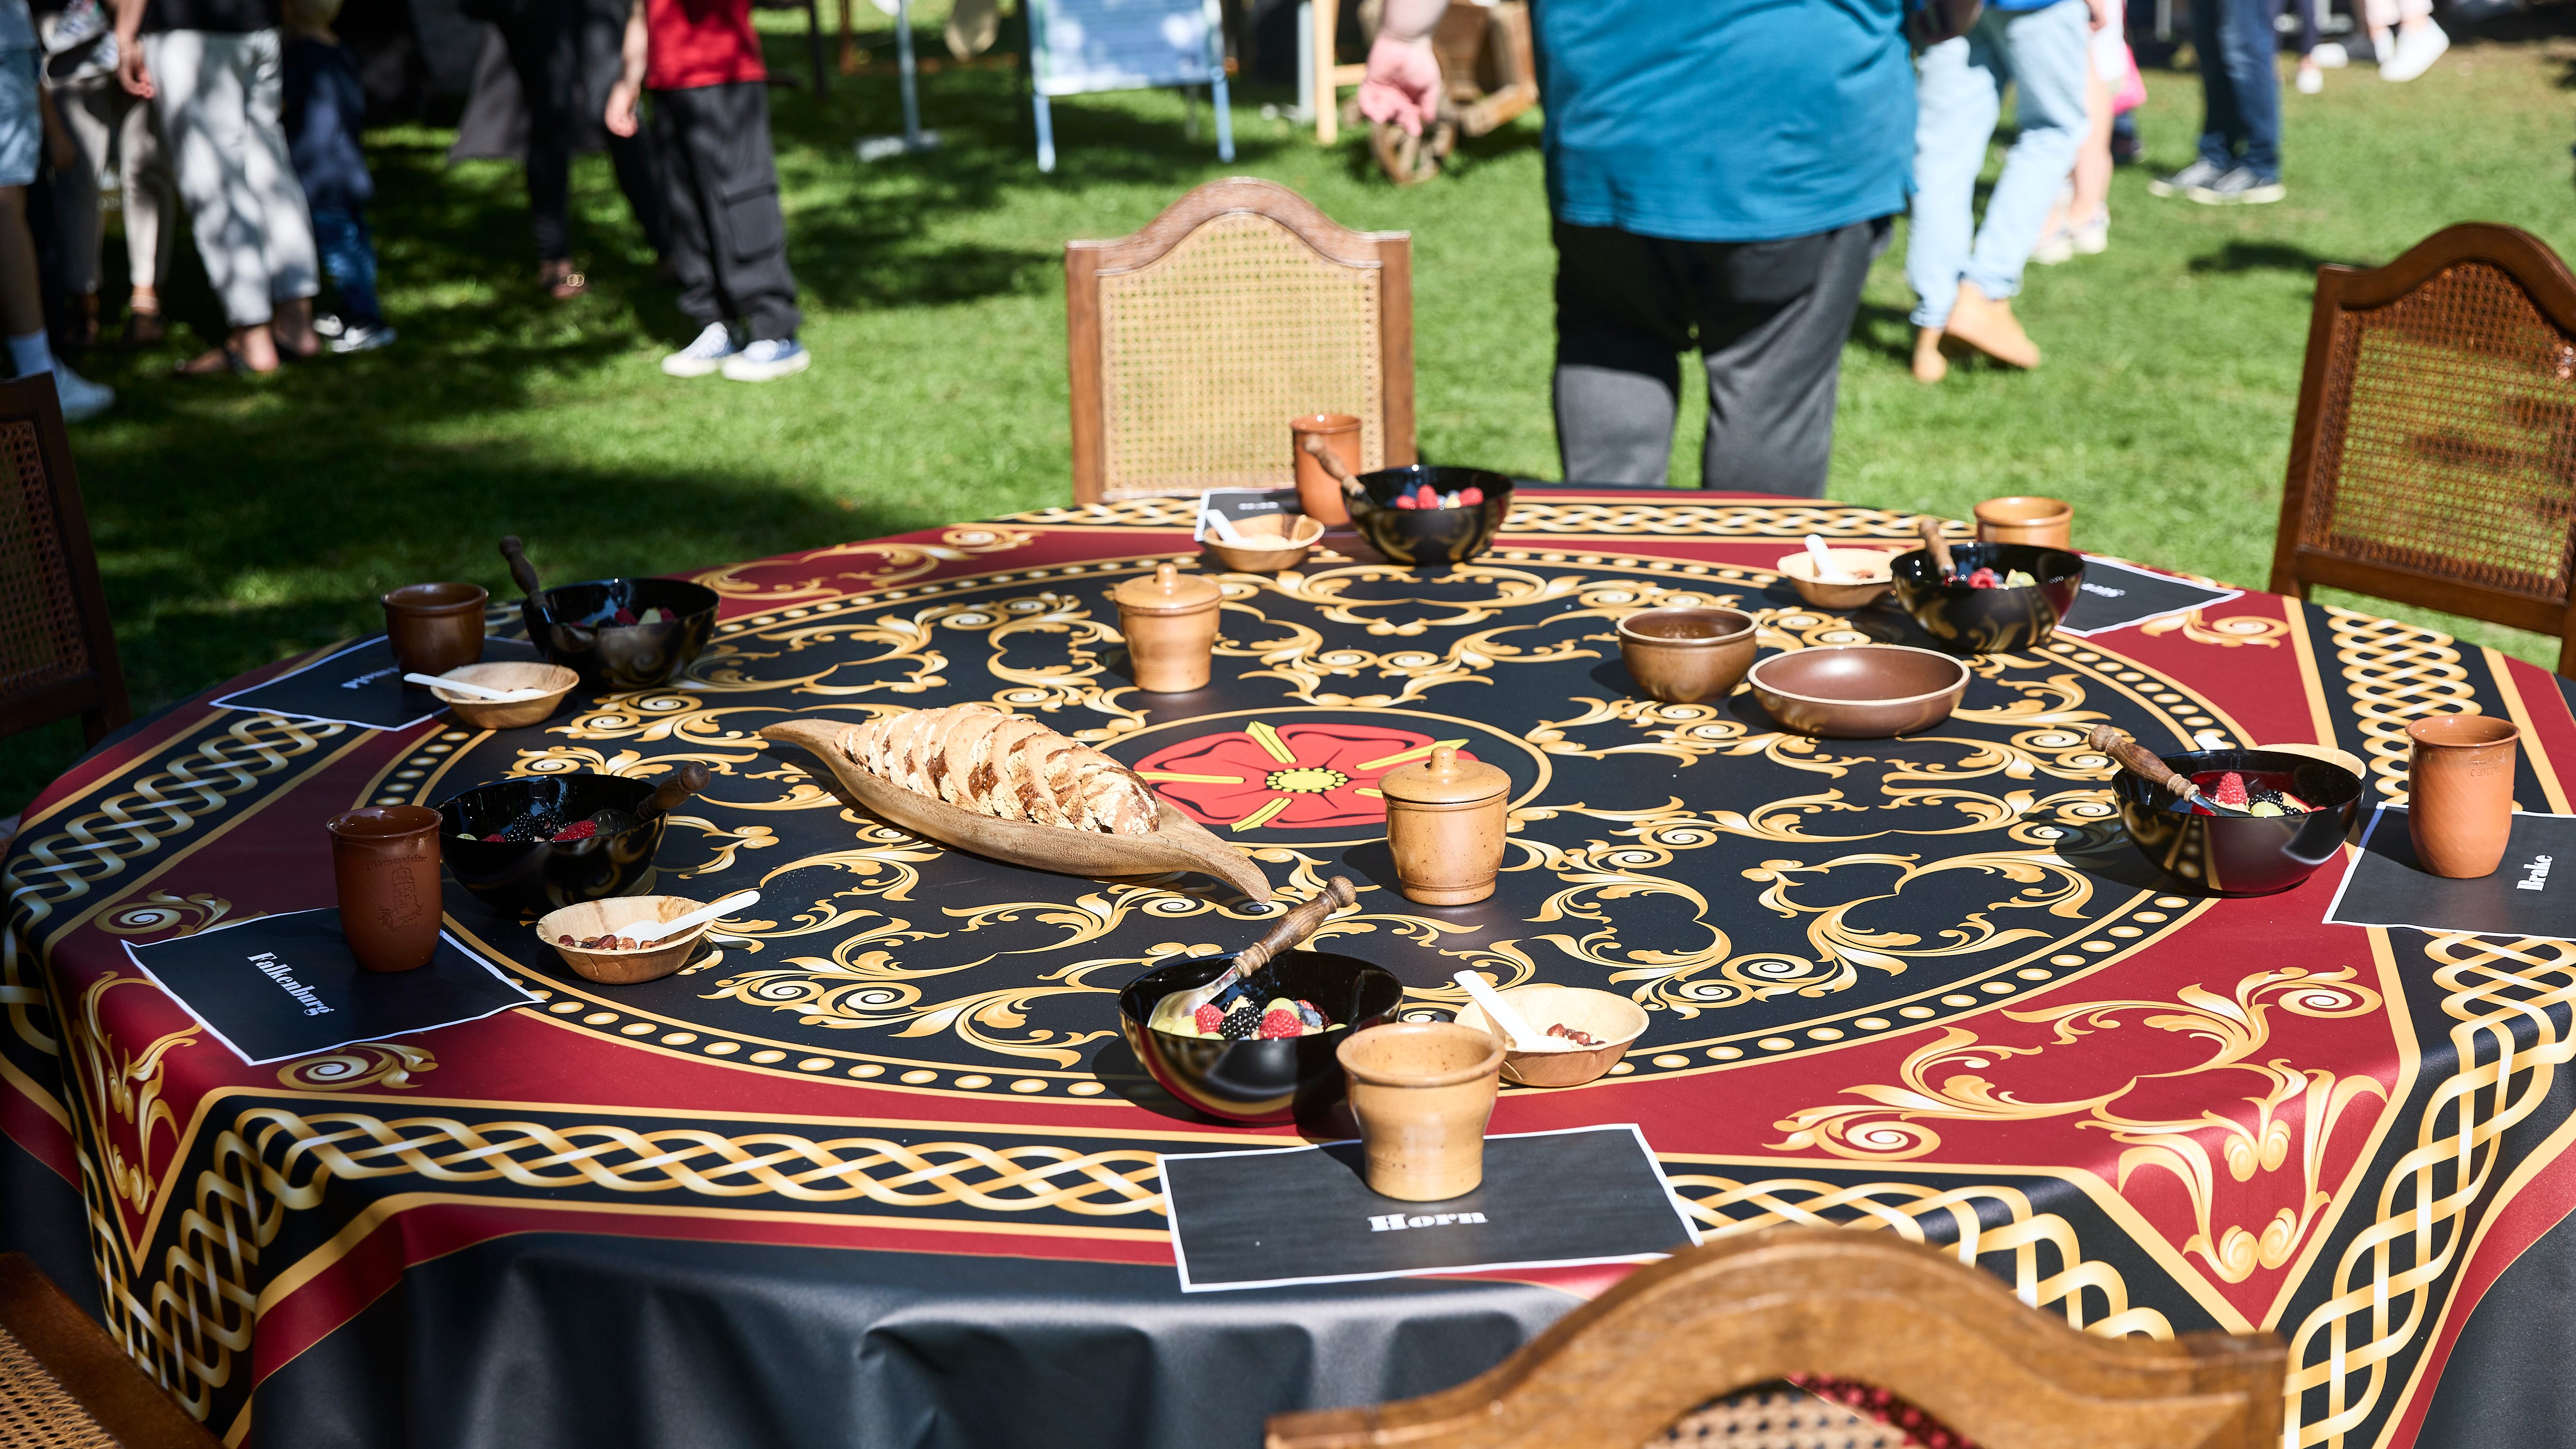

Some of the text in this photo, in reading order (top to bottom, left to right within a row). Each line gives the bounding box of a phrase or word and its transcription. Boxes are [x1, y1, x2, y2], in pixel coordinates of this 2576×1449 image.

[2516, 855, 2553, 891] Brake
[247, 952, 335, 1016] Falkenburg
[1367, 1212, 1489, 1232] Horn
